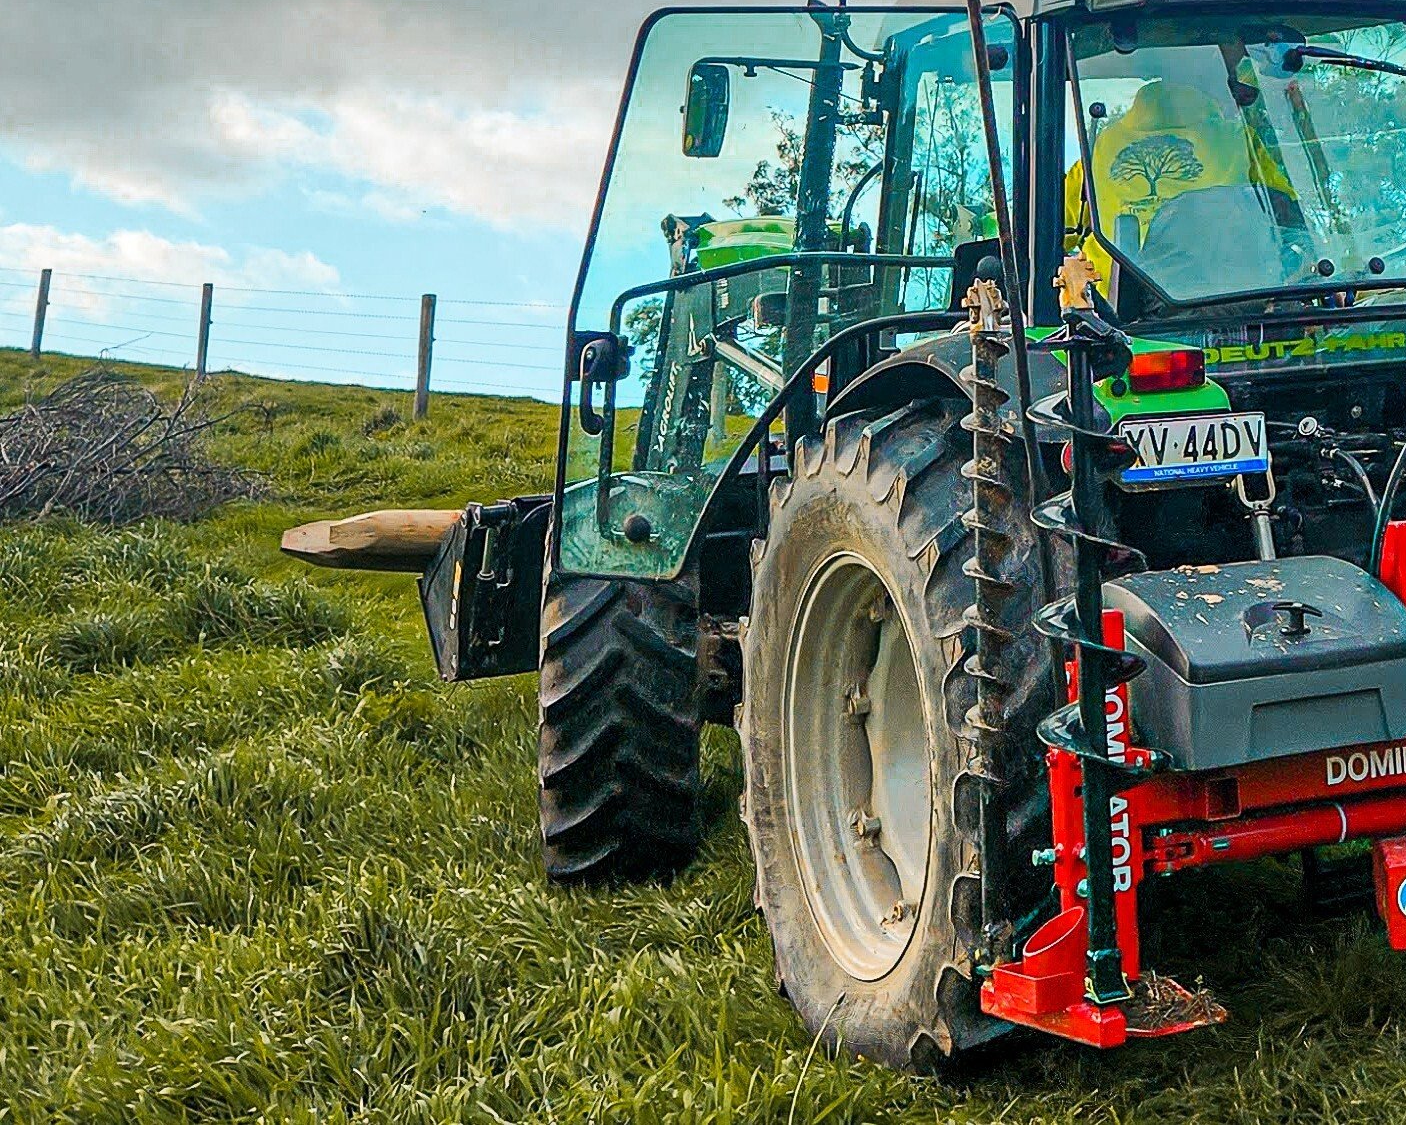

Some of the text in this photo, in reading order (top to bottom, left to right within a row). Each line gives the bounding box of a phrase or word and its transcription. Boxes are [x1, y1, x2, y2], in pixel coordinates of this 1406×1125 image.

[1154, 463, 1238, 476] NATIONAL HEAVY VEHICLE
